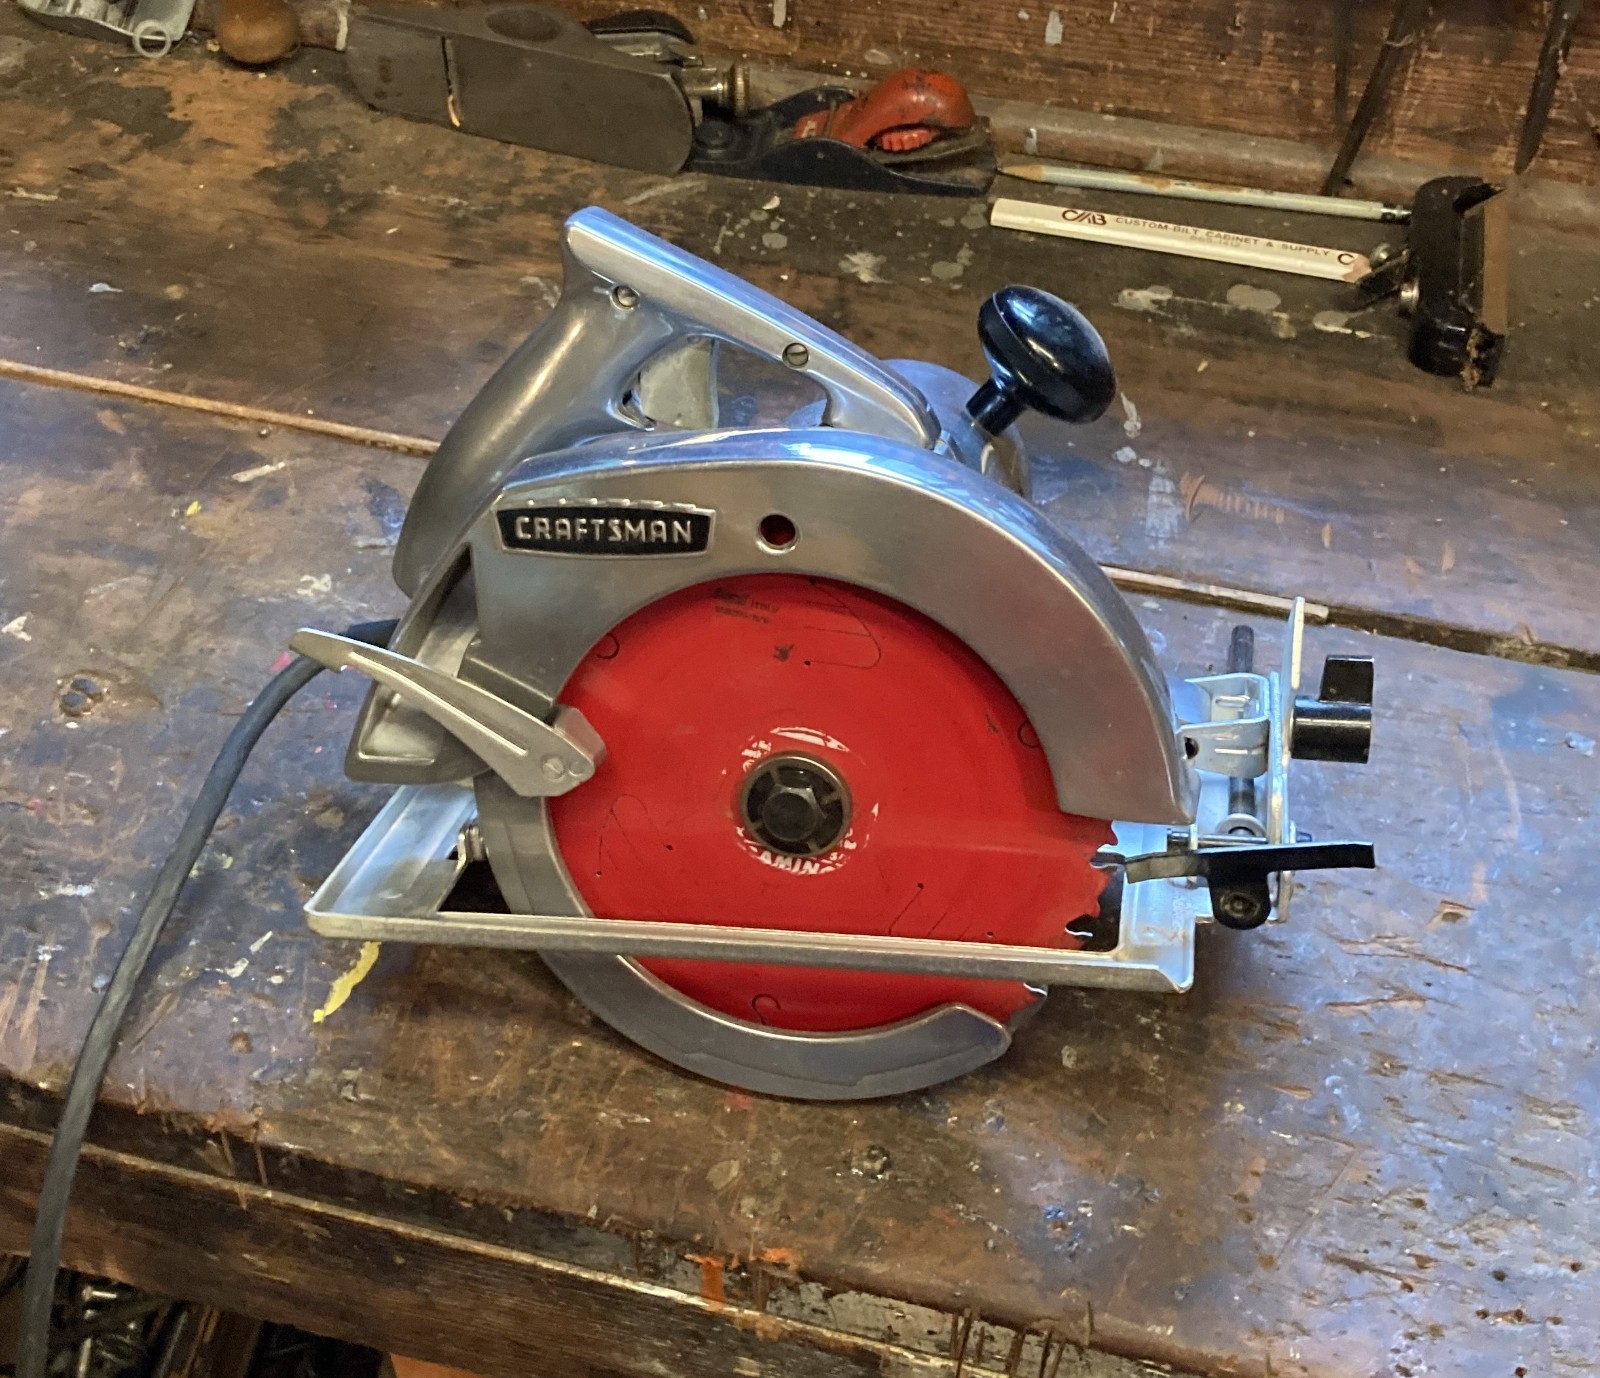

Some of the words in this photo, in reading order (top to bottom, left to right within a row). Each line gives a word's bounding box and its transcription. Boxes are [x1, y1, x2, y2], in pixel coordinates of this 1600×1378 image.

[1206, 231, 1258, 245] CABINET
[1282, 244, 1330, 256] SUPPLY
[515, 516, 691, 543] CRAFTSMAN
